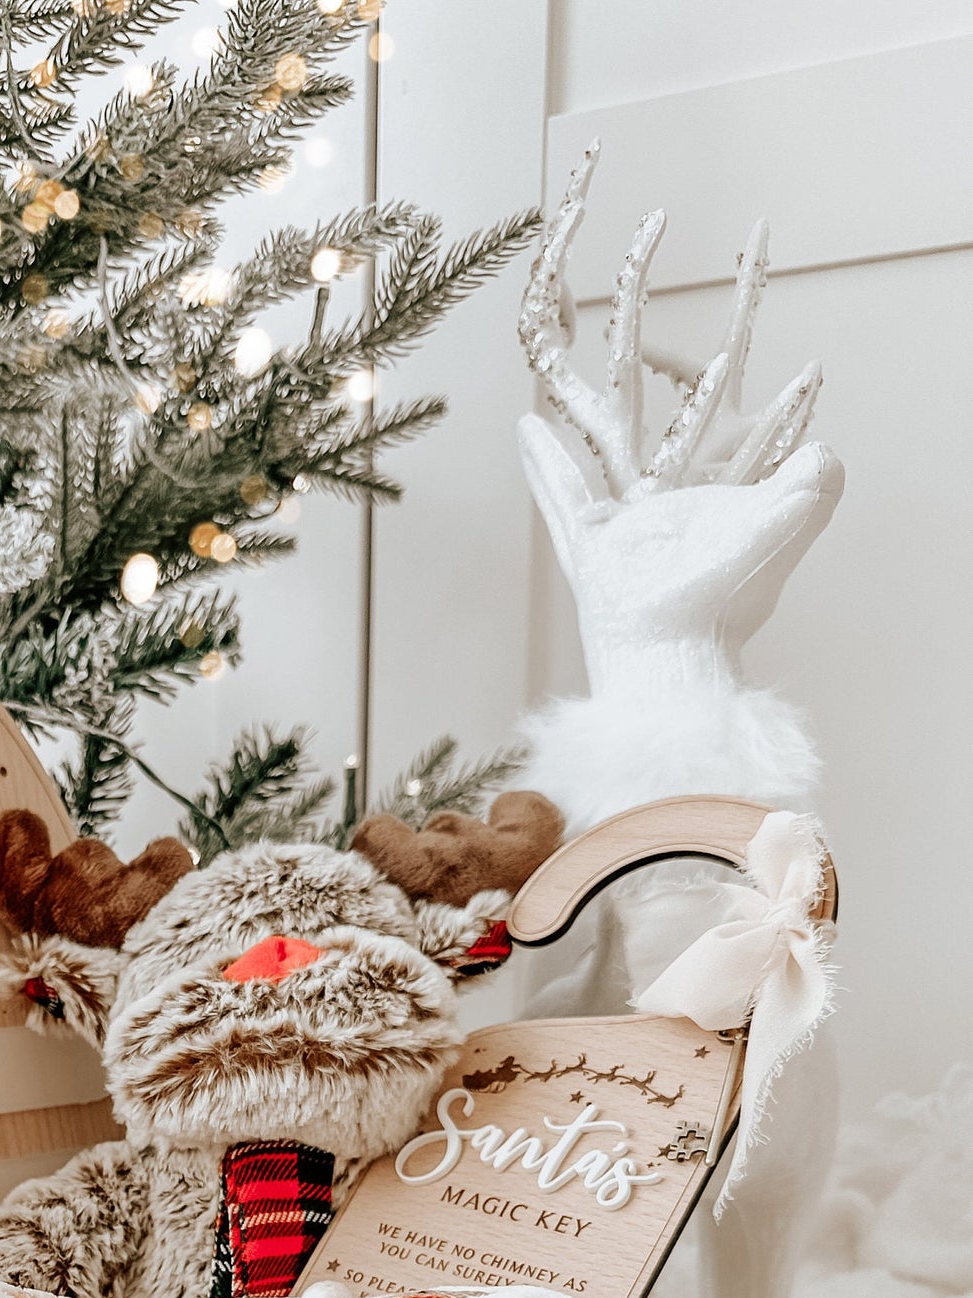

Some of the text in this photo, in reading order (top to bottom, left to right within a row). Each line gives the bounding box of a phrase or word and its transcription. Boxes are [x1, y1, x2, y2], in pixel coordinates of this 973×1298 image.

[394, 1087, 664, 1212] Santa's
[440, 1184, 593, 1239] MAGIC KEY
[343, 1268, 364, 1284] SO
[378, 1222, 588, 1293] WE HAVE NO CHIMNEY AS
[379, 1241, 413, 1260] YOU
[414, 1252, 451, 1272] CAN
